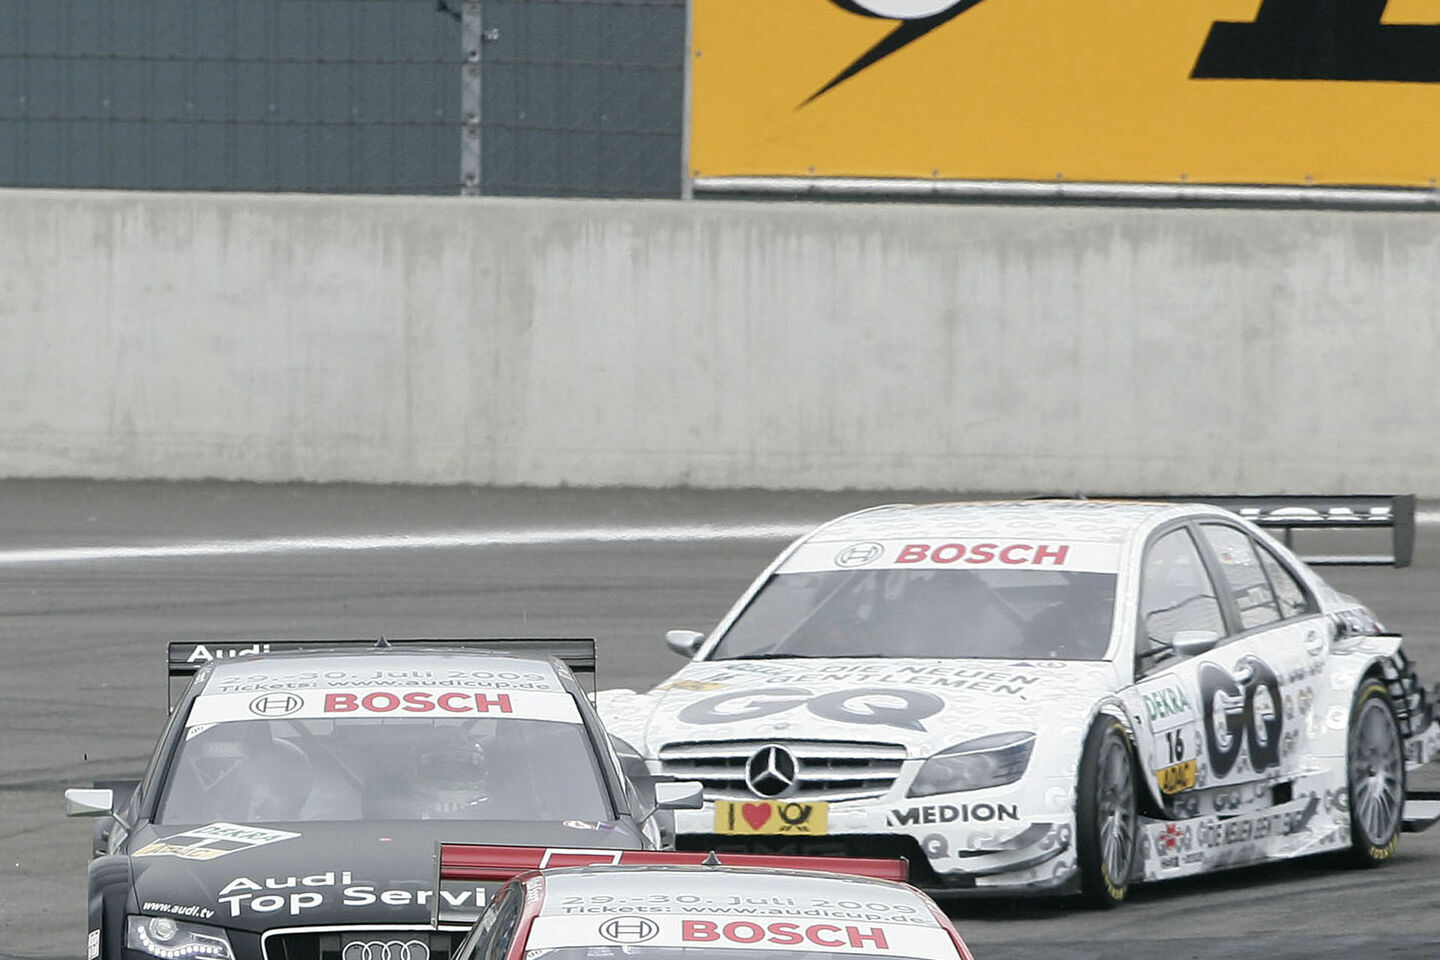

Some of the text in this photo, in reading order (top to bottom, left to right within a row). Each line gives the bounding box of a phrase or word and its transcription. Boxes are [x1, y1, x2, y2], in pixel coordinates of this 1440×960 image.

[893, 543, 1069, 566] BOSCH
[372, 670, 433, 680] Juli
[448, 670, 546, 683] 2009
[898, 665, 1041, 686] NEUEN
[323, 692, 514, 715] BOSCH
[676, 687, 946, 732] GQ
[1142, 685, 1193, 721] DEKRA
[1199, 654, 1283, 779] GQ
[1165, 729, 1185, 764] 16
[887, 802, 1020, 828] MEDION
[218, 871, 353, 895] Audi
[142, 900, 215, 920] www.audi.tv
[218, 890, 324, 918] Top
[343, 885, 496, 908] Servi
[560, 905, 673, 916] Tickets:
[728, 895, 797, 908] Juli
[812, 898, 918, 915] 2009
[681, 919, 890, 950] BOSCH
